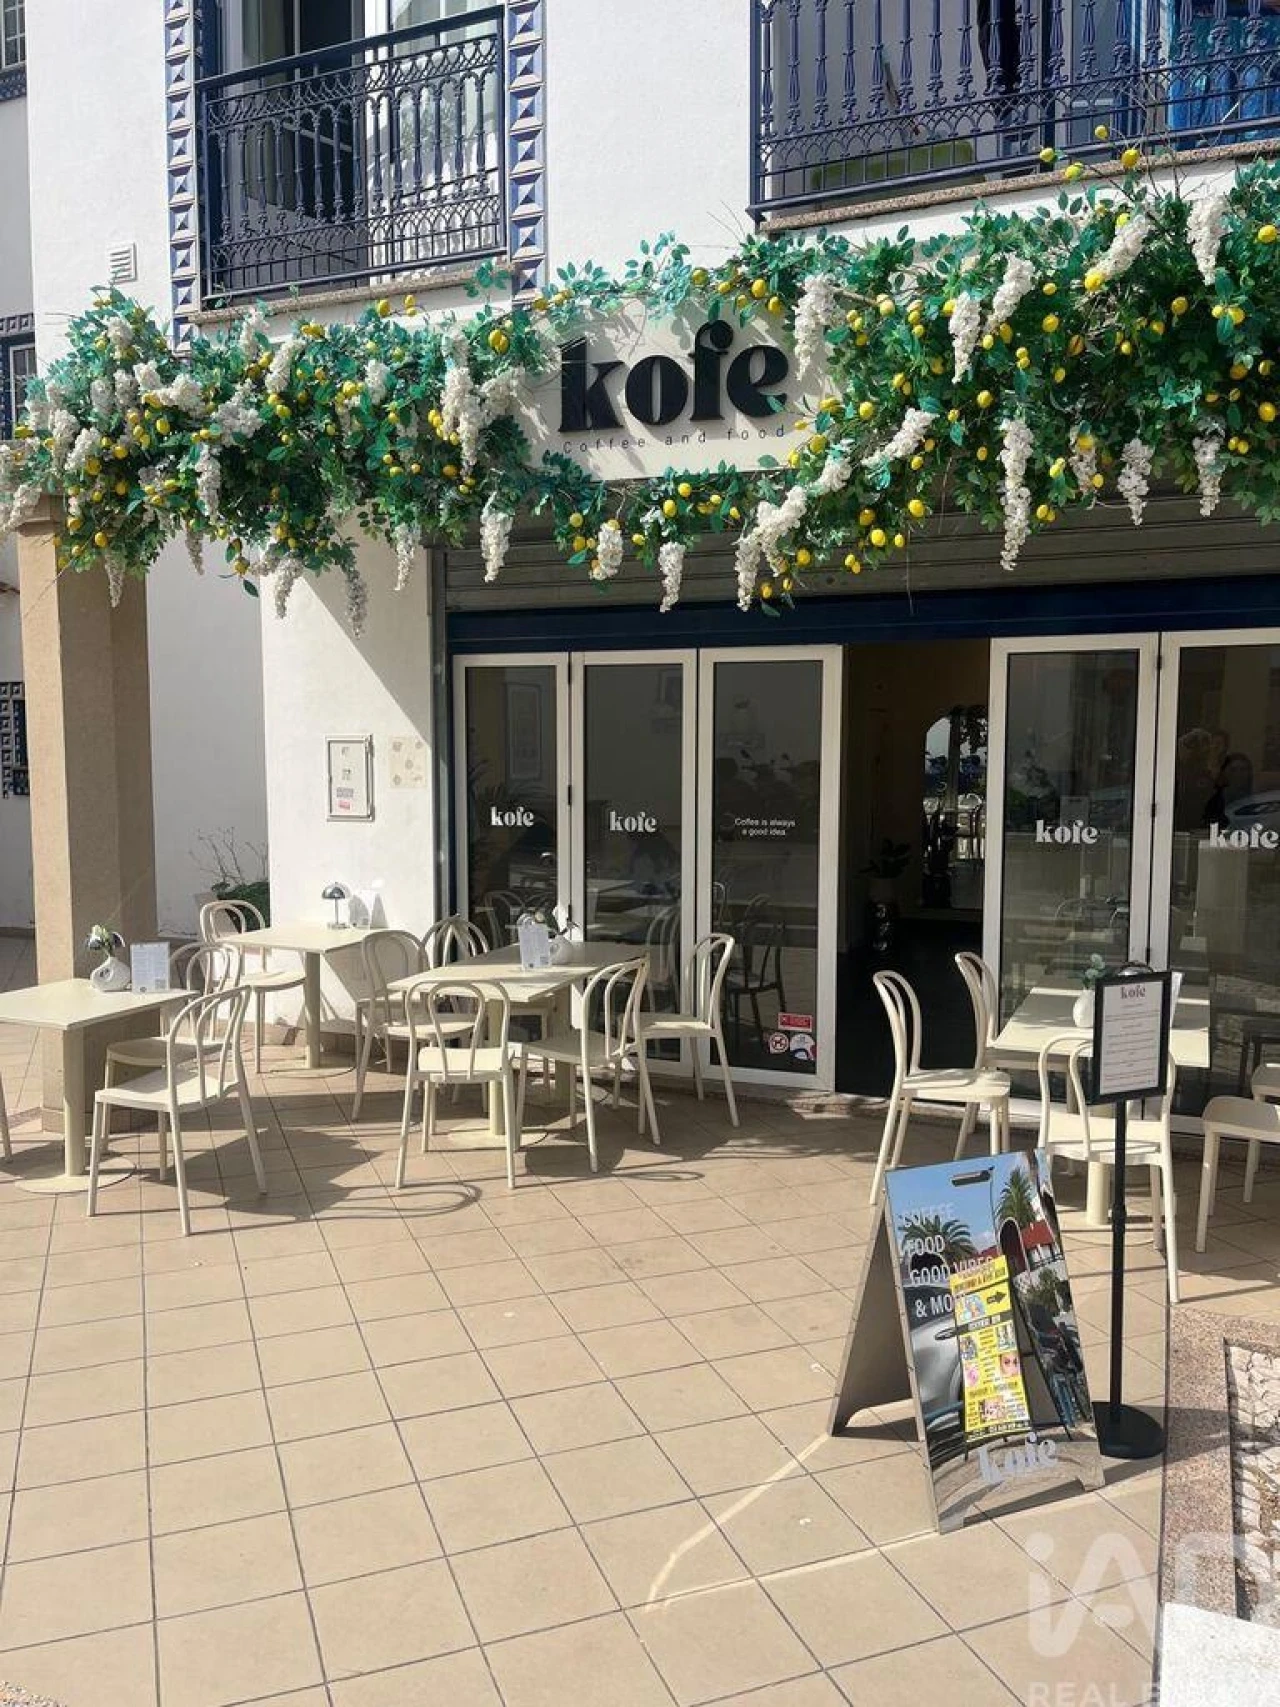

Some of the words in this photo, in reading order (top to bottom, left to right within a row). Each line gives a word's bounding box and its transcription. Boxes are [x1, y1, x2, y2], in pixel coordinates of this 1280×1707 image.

[558, 319, 790, 433] kofe
[563, 436, 646, 454] Coffee
[664, 431, 706, 447] and
[727, 425, 785, 442] food
[490, 806, 535, 827] kofe
[609, 810, 657, 833] kofe
[1035, 819, 1099, 844] kofe
[1209, 822, 1279, 849] kofe
[906, 1234, 945, 1258] FOOD
[909, 1264, 951, 1286] GOOD
[914, 1299, 928, 1319] &
